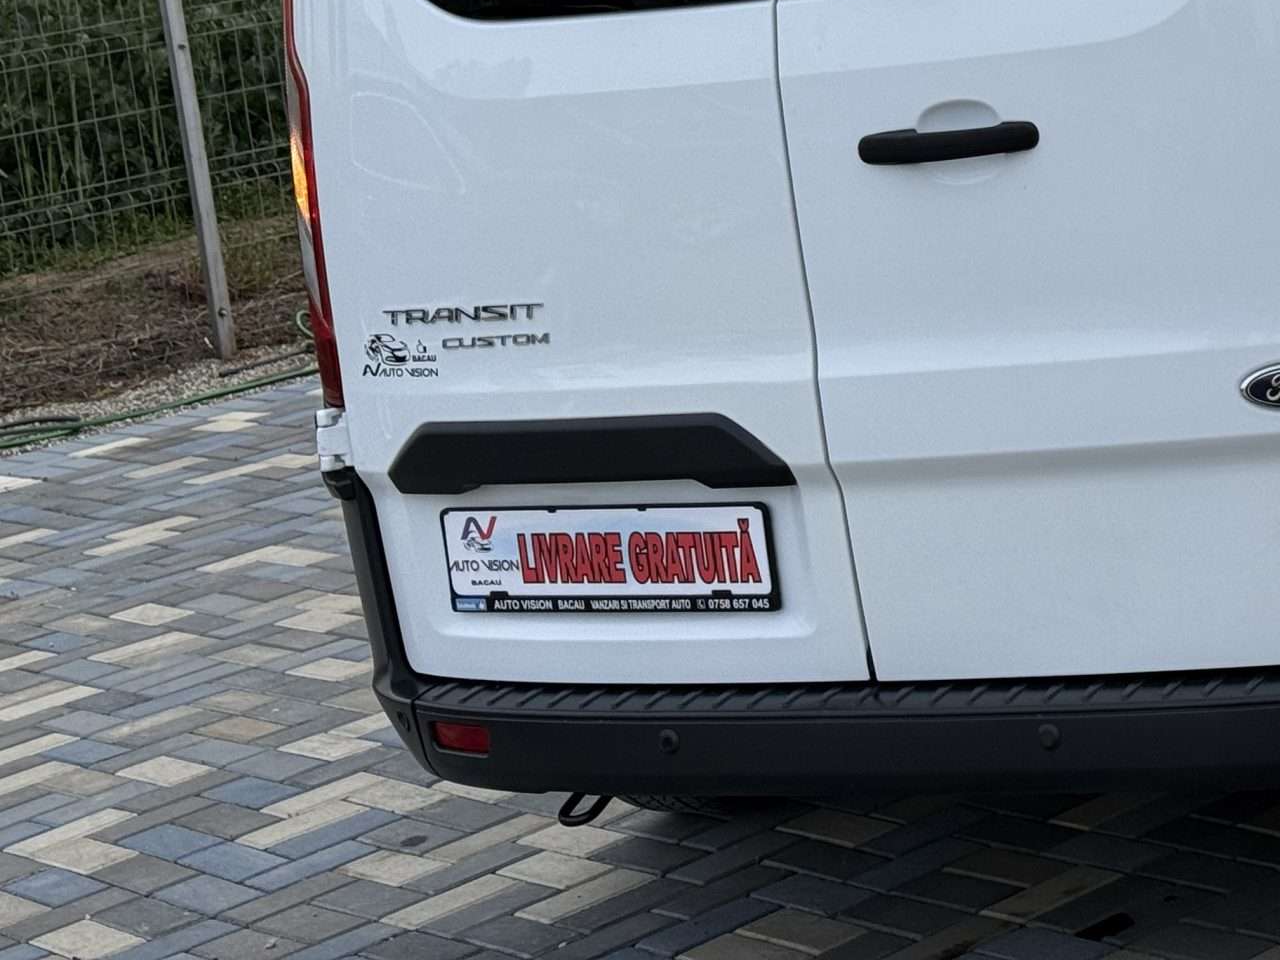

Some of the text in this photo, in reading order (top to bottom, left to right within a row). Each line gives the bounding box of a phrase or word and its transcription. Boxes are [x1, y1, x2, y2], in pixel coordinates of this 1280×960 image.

[382, 302, 545, 327] TRANSIT
[441, 332, 550, 351] CUSTOM
[516, 517, 763, 585] LIVRARE GRATUITĂ
[450, 559, 520, 572] AUTO VISION
[494, 599, 520, 610] AUTO
[521, 599, 553, 610] VISION
[558, 599, 585, 610] BACAU
[627, 599, 670, 610] TRANSPORT
[671, 598, 691, 609] AUTO
[708, 598, 731, 609] 0758
[732, 598, 749, 609] 657
[752, 598, 770, 609] 045
